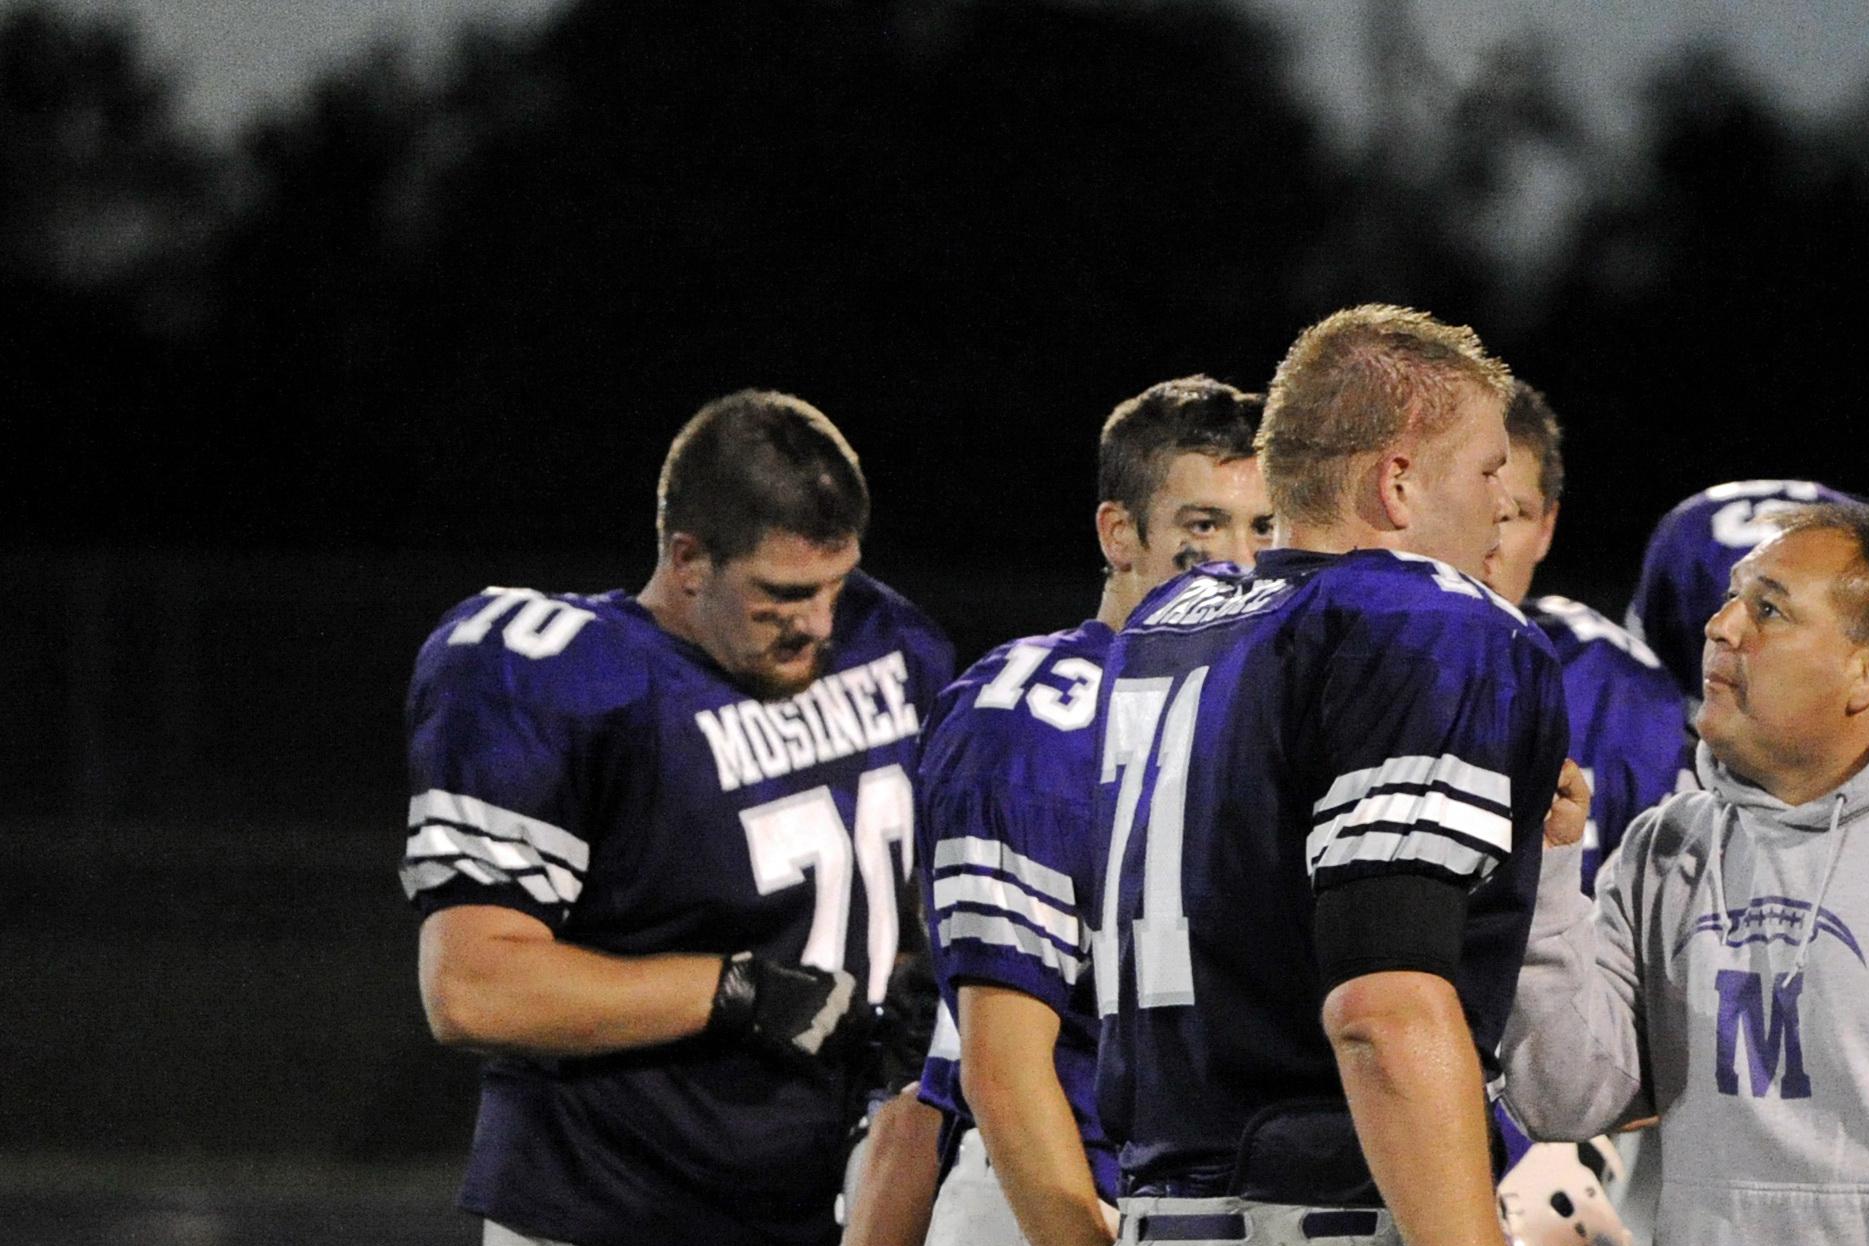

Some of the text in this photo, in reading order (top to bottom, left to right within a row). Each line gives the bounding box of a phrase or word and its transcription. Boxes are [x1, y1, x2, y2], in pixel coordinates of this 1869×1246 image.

[447, 586, 596, 660] 70
[973, 644, 1103, 732] 13
[694, 650, 920, 793] MOSINEE
[1092, 664, 1210, 1020] 71
[1714, 969, 1812, 1100] M
